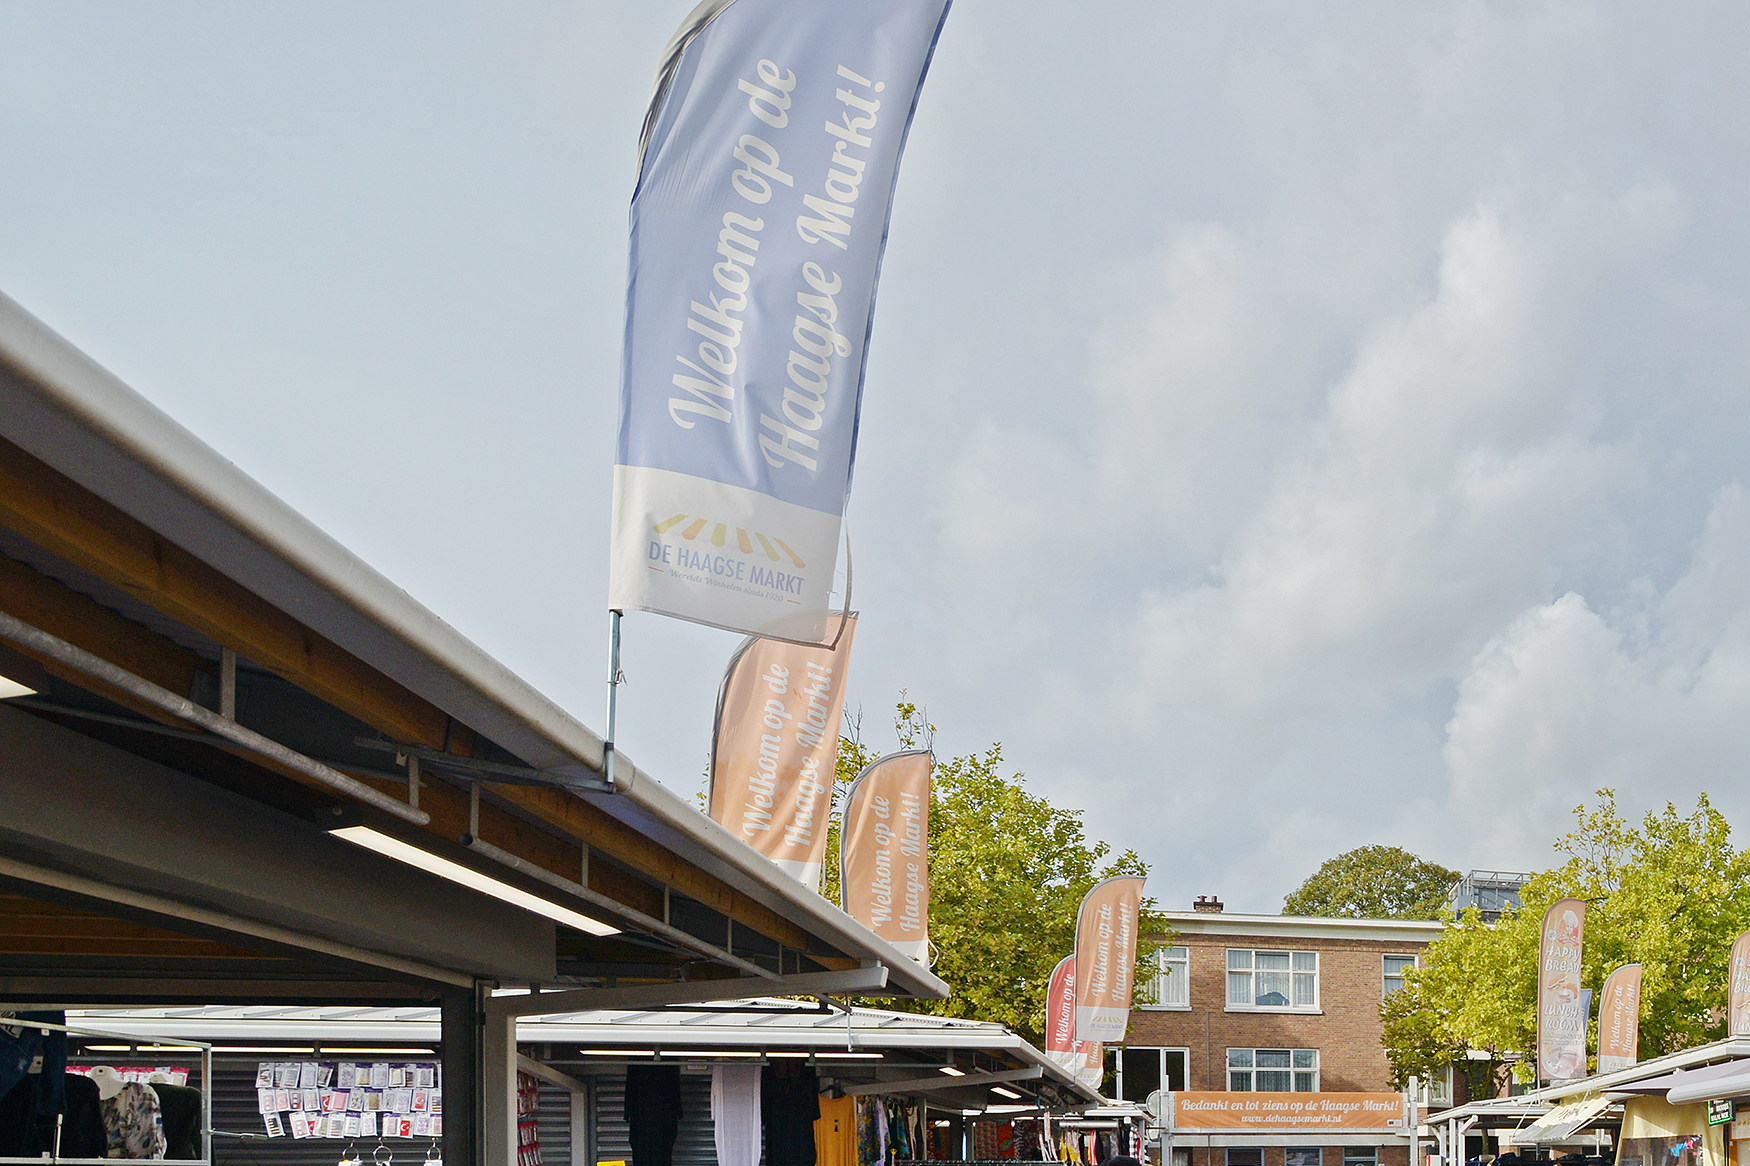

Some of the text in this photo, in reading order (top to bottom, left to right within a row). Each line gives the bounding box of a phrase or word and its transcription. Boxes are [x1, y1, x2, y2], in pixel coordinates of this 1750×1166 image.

[668, 58, 796, 430] Welkom op de
[757, 64, 888, 472] Haagse Markt!
[649, 541, 805, 595] DE HAAGSE MARKT
[743, 586, 764, 598] sinds
[765, 592, 784, 602] 1920
[743, 663, 793, 838] Welkom op de
[785, 661, 833, 848] Haagse Markt!
[870, 795, 897, 928] Welkom op de
[899, 791, 928, 934] Haagse Markt!
[1091, 903, 1114, 997] Welkom op de
[1112, 902, 1133, 1002] Haagse Markt!
[1544, 958, 1580, 974] BREAD
[1545, 945, 1580, 962] HAPPY
[1056, 974, 1076, 1044] Welkom op de
[1544, 1004, 1580, 1018] LUNCH
[1545, 1018, 1578, 1032] ROOM
[1609, 984, 1625, 1050] Welkom op de
[1622, 1018, 1635, 1053] Haagse
[1181, 1100, 1399, 1114] Bedankt en tot ziens op de Haagse Markt!
[1241, 1114, 1342, 1125] www.dehaagsemarkt.nl
